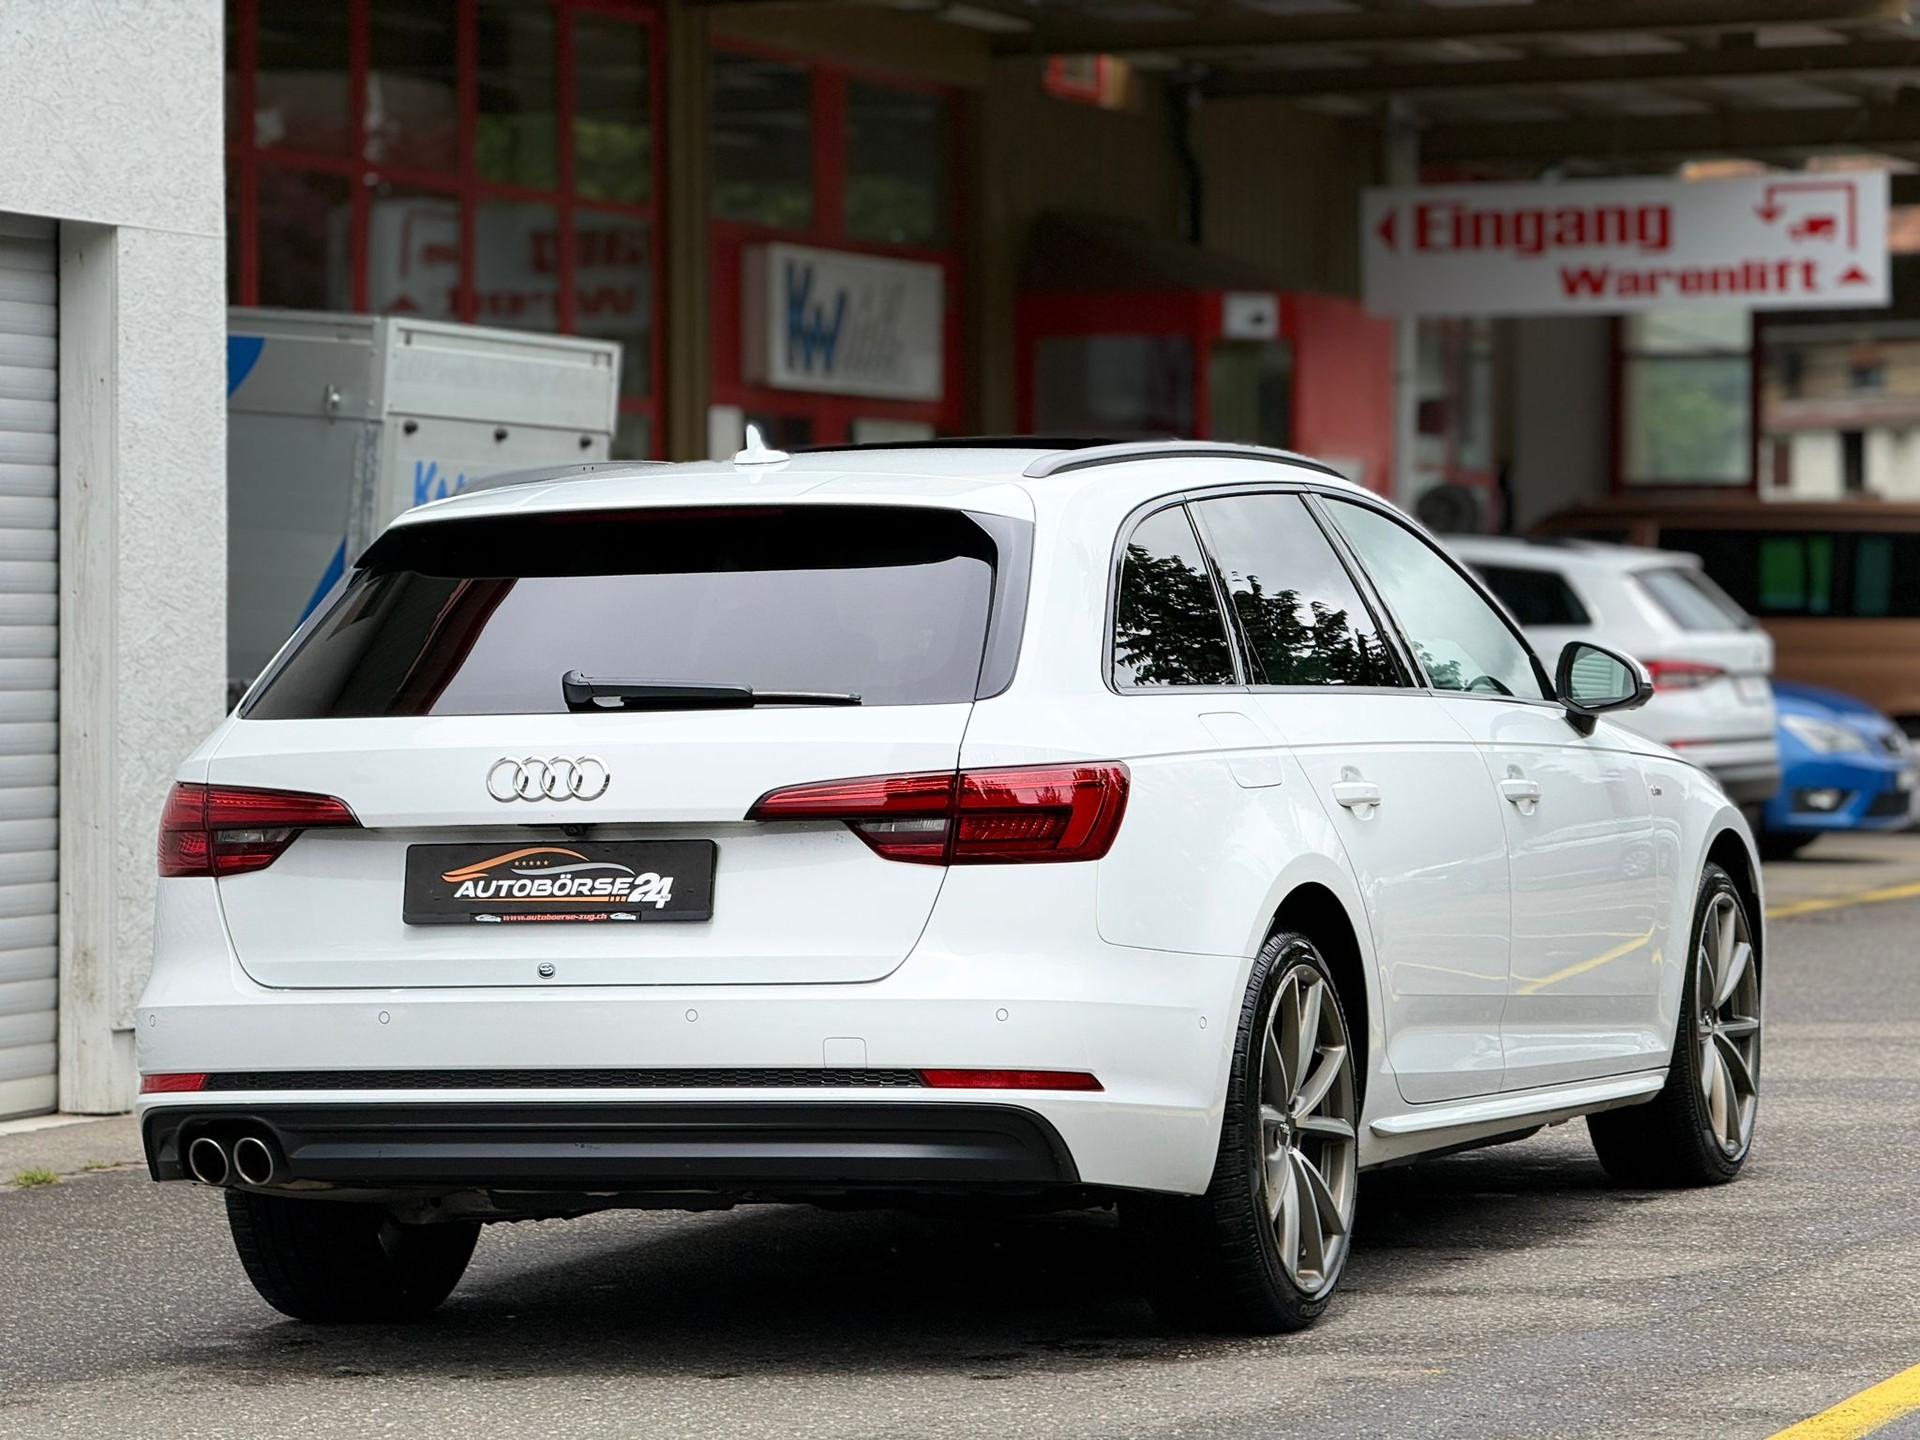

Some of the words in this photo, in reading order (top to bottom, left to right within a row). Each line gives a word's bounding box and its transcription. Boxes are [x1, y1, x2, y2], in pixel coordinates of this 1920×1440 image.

[1413, 202, 1671, 257] Eingang
[1559, 258, 1818, 297] Warenlift
[502, 912, 608, 921] www.autoboerse-zug.ch
